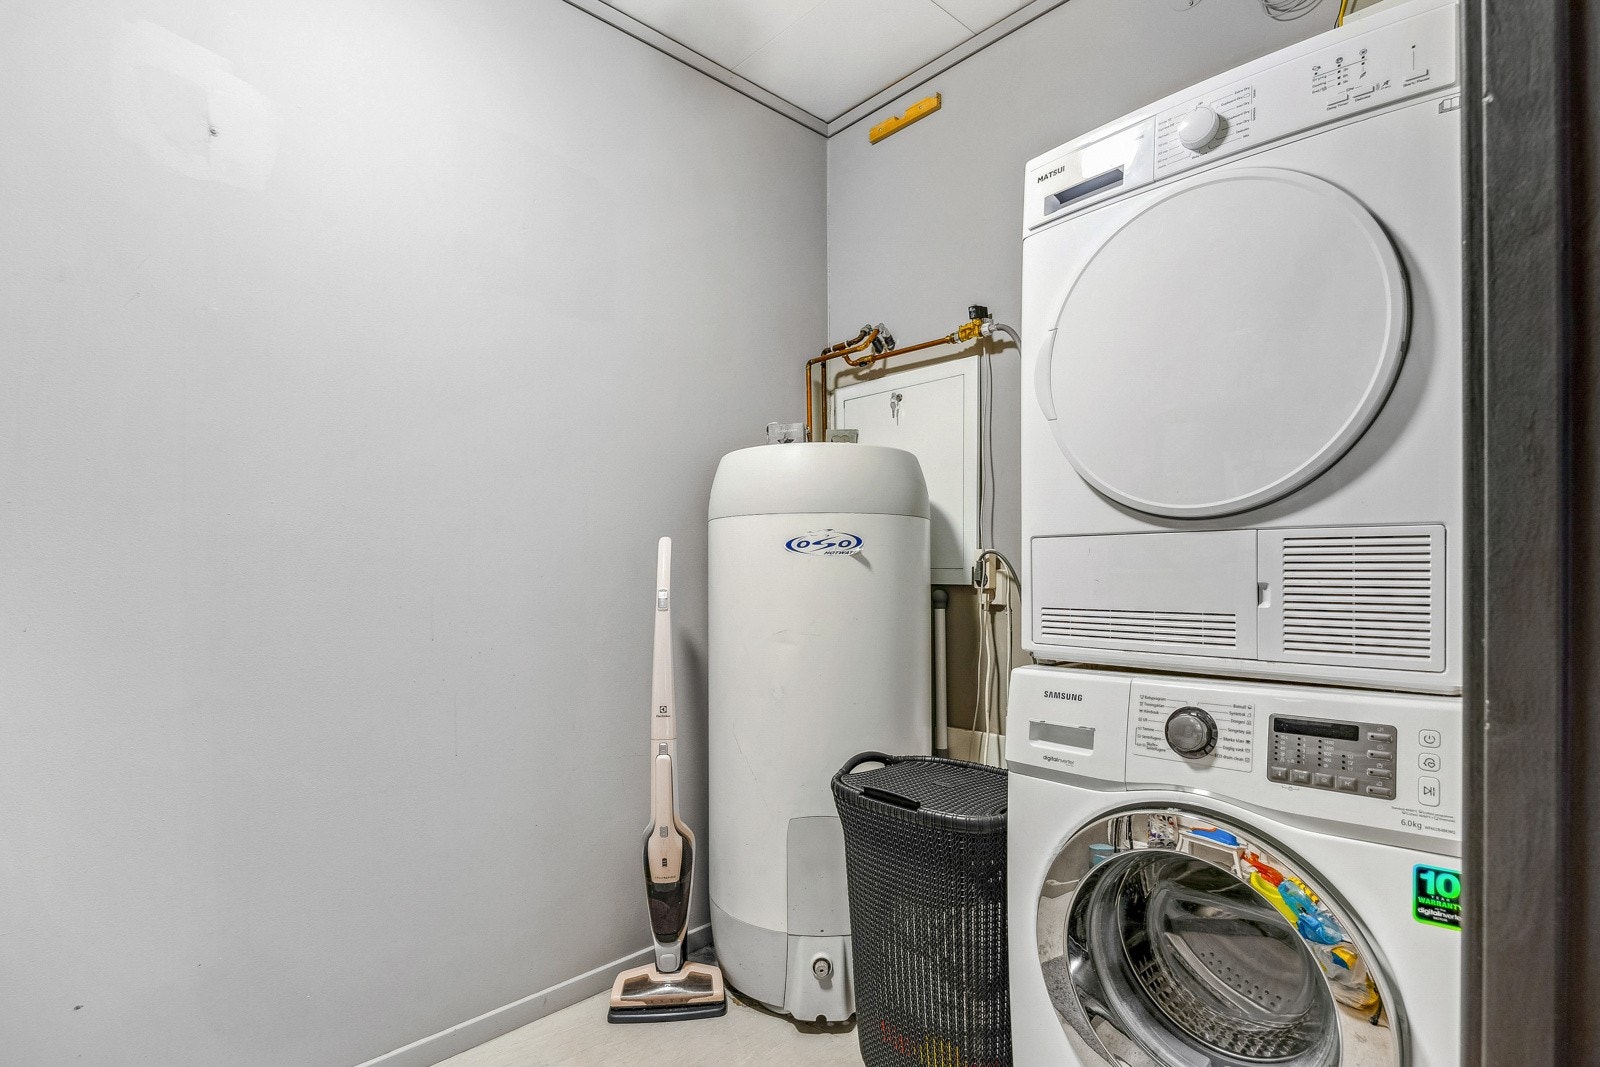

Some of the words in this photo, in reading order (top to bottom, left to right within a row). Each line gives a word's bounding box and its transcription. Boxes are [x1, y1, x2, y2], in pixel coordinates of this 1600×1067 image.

[1037, 165, 1065, 184] MATSUI
[1043, 690, 1083, 702] SAMSUNG
[1401, 818, 1422, 831] 6.0kg
[1420, 870, 1461, 899] 10
